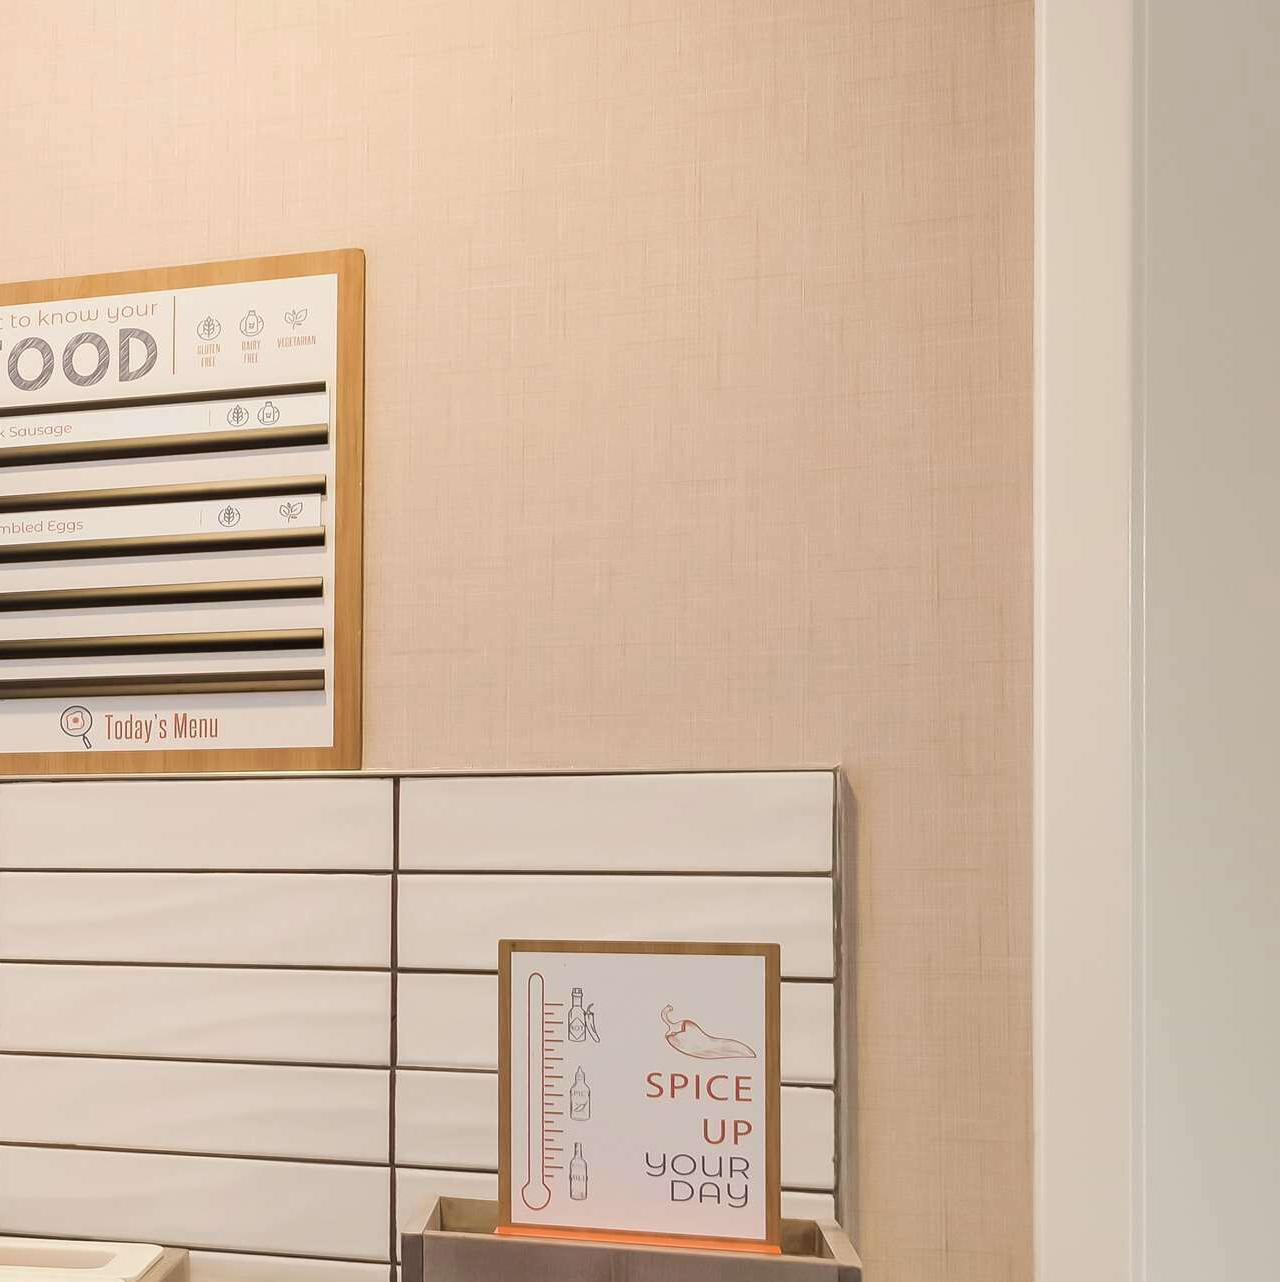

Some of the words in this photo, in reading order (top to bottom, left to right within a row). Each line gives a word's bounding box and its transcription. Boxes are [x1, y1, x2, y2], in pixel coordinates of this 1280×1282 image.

[10, 313, 31, 329] to
[38, 309, 99, 327] know
[107, 303, 158, 324] your
[197, 343, 221, 355] GLUTEN
[241, 340, 261, 351] DAIRY
[277, 335, 317, 348] VEGETARIAN
[9, 424, 73, 438] Sausage
[47, 519, 84, 534] Eggs
[105, 713, 167, 743] Today's
[174, 713, 218, 739] Menu
[645, 1071, 753, 1102] SPICE
[702, 1118, 753, 1145] UP
[645, 1151, 750, 1179] YOUR
[670, 1179, 750, 1208] DAY
